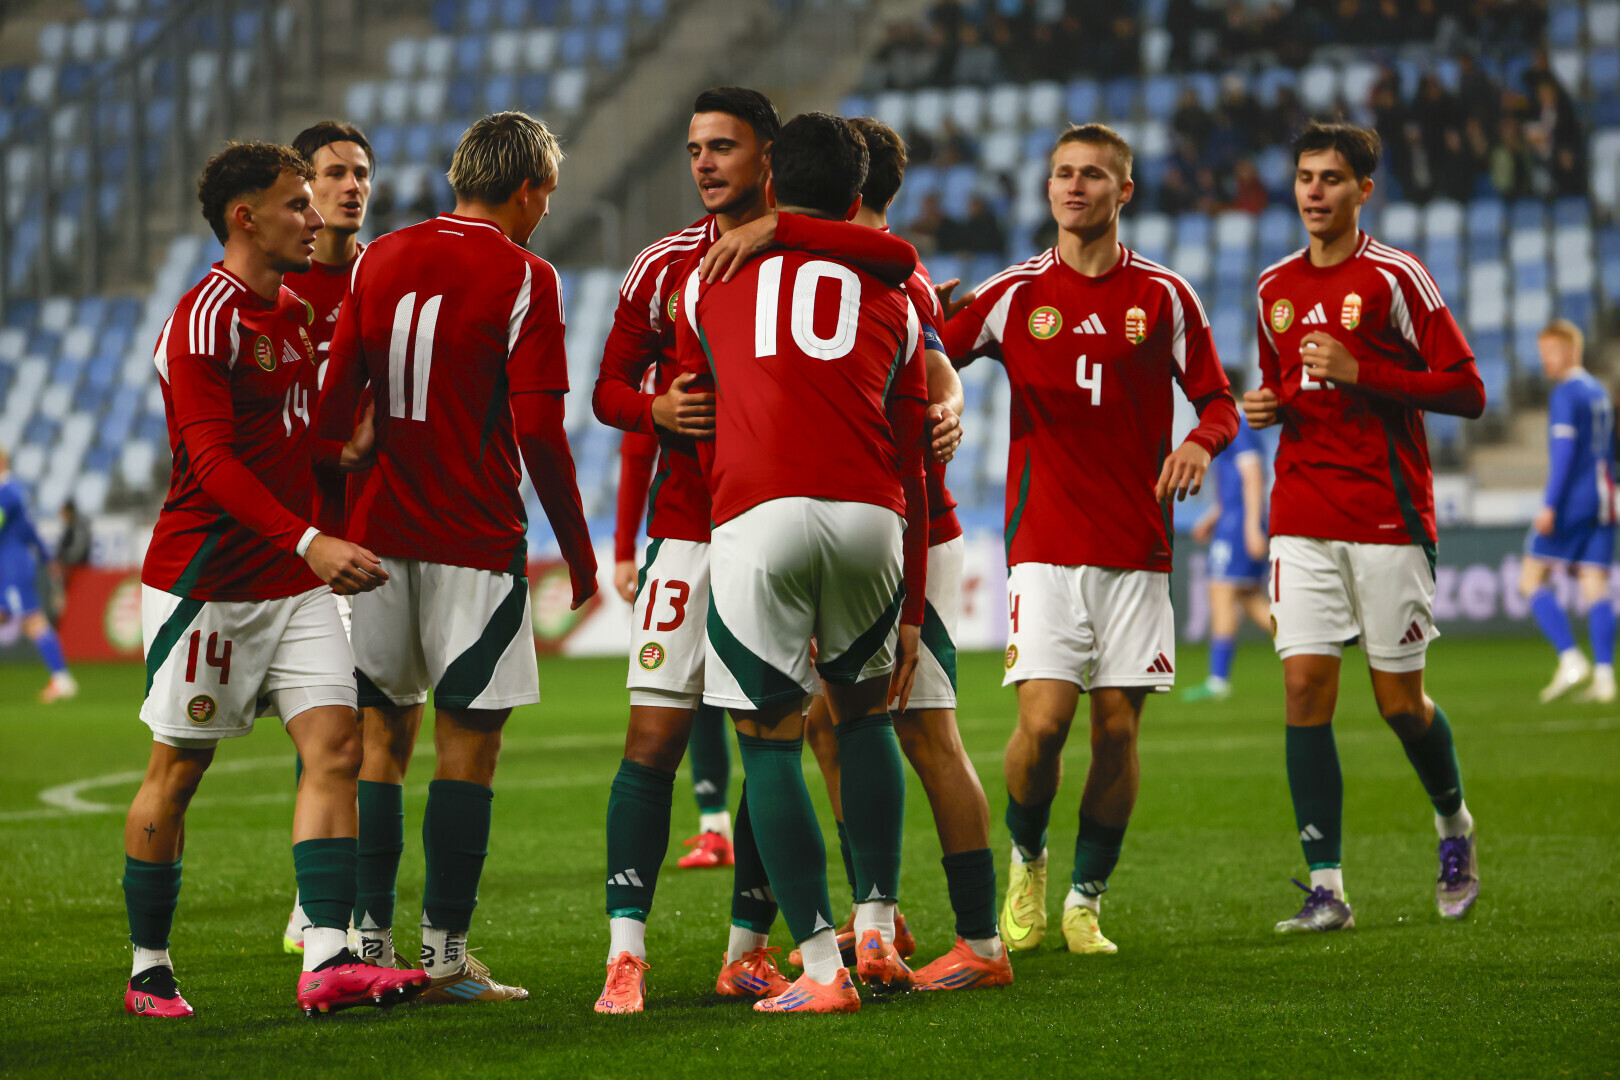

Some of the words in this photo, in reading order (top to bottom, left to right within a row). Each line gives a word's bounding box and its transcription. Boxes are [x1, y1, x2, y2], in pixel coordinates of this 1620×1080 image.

[754, 255, 862, 361] 10
[389, 291, 443, 422] 11
[1076, 354, 1103, 406] 4
[283, 382, 310, 437] 14
[643, 578, 690, 632] 13
[185, 629, 232, 685] 14
